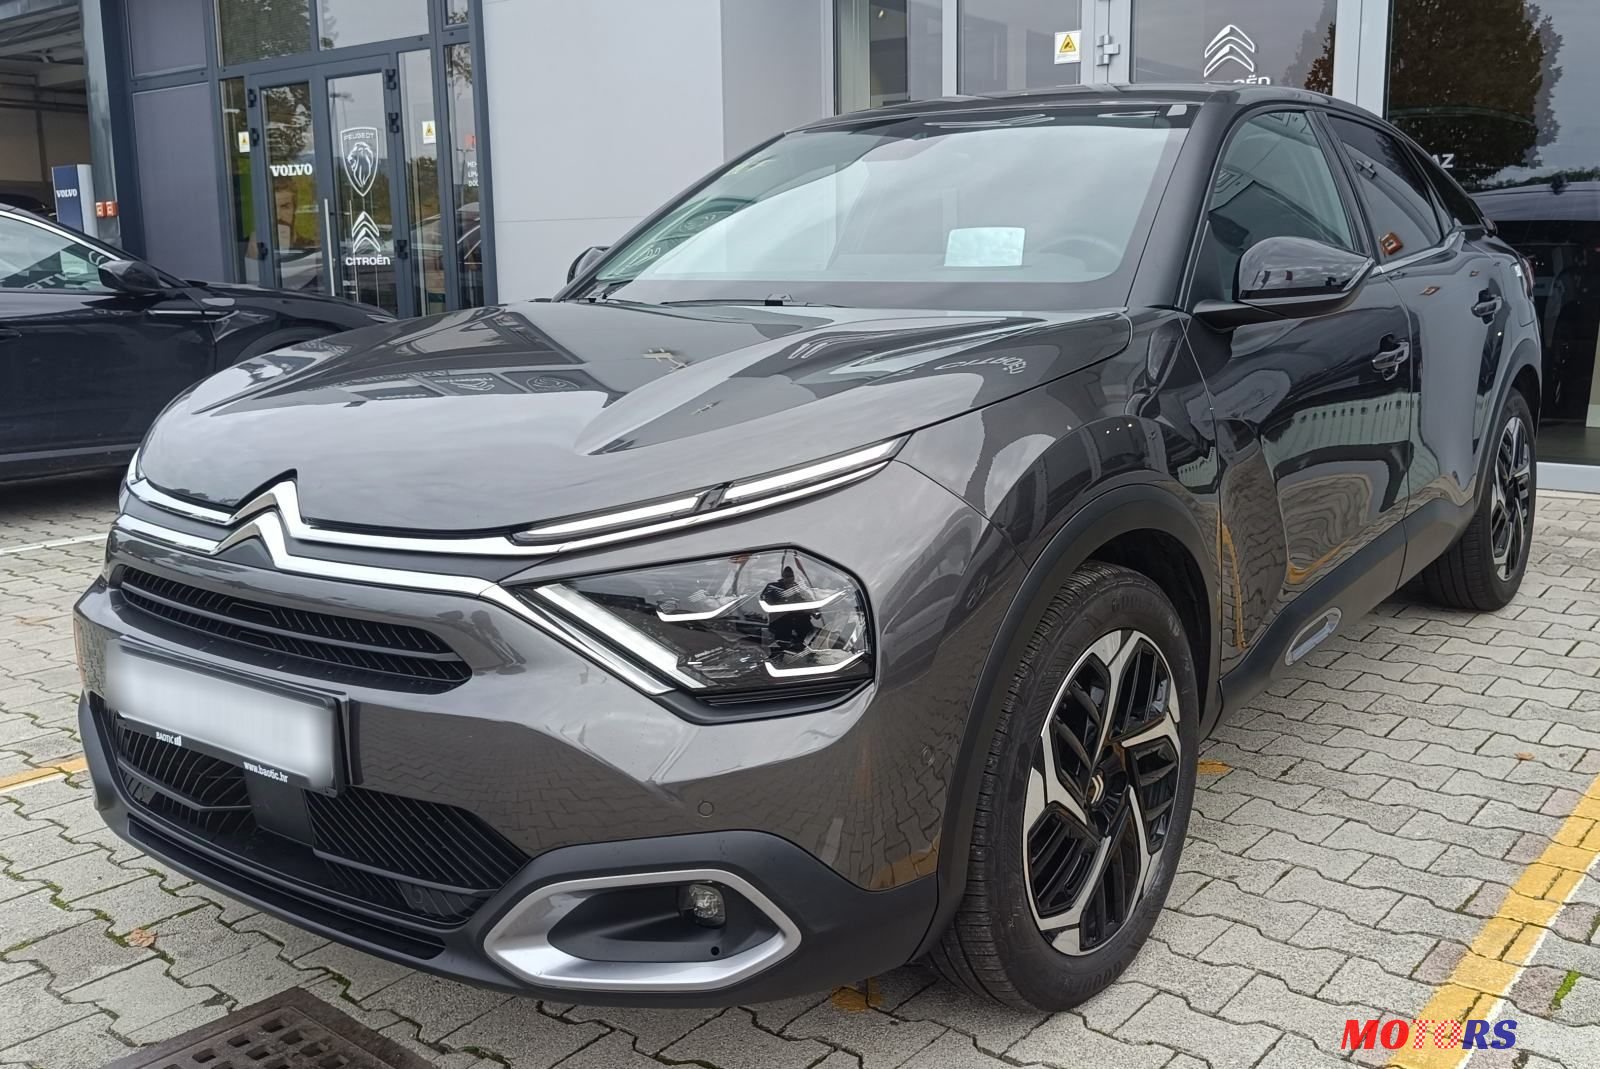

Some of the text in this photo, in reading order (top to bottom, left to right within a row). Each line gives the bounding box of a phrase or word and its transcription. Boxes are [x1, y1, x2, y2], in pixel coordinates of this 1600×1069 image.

[269, 163, 313, 177] VOLVO
[56, 188, 78, 198] VOLVO
[345, 254, 391, 266] CITROËN
